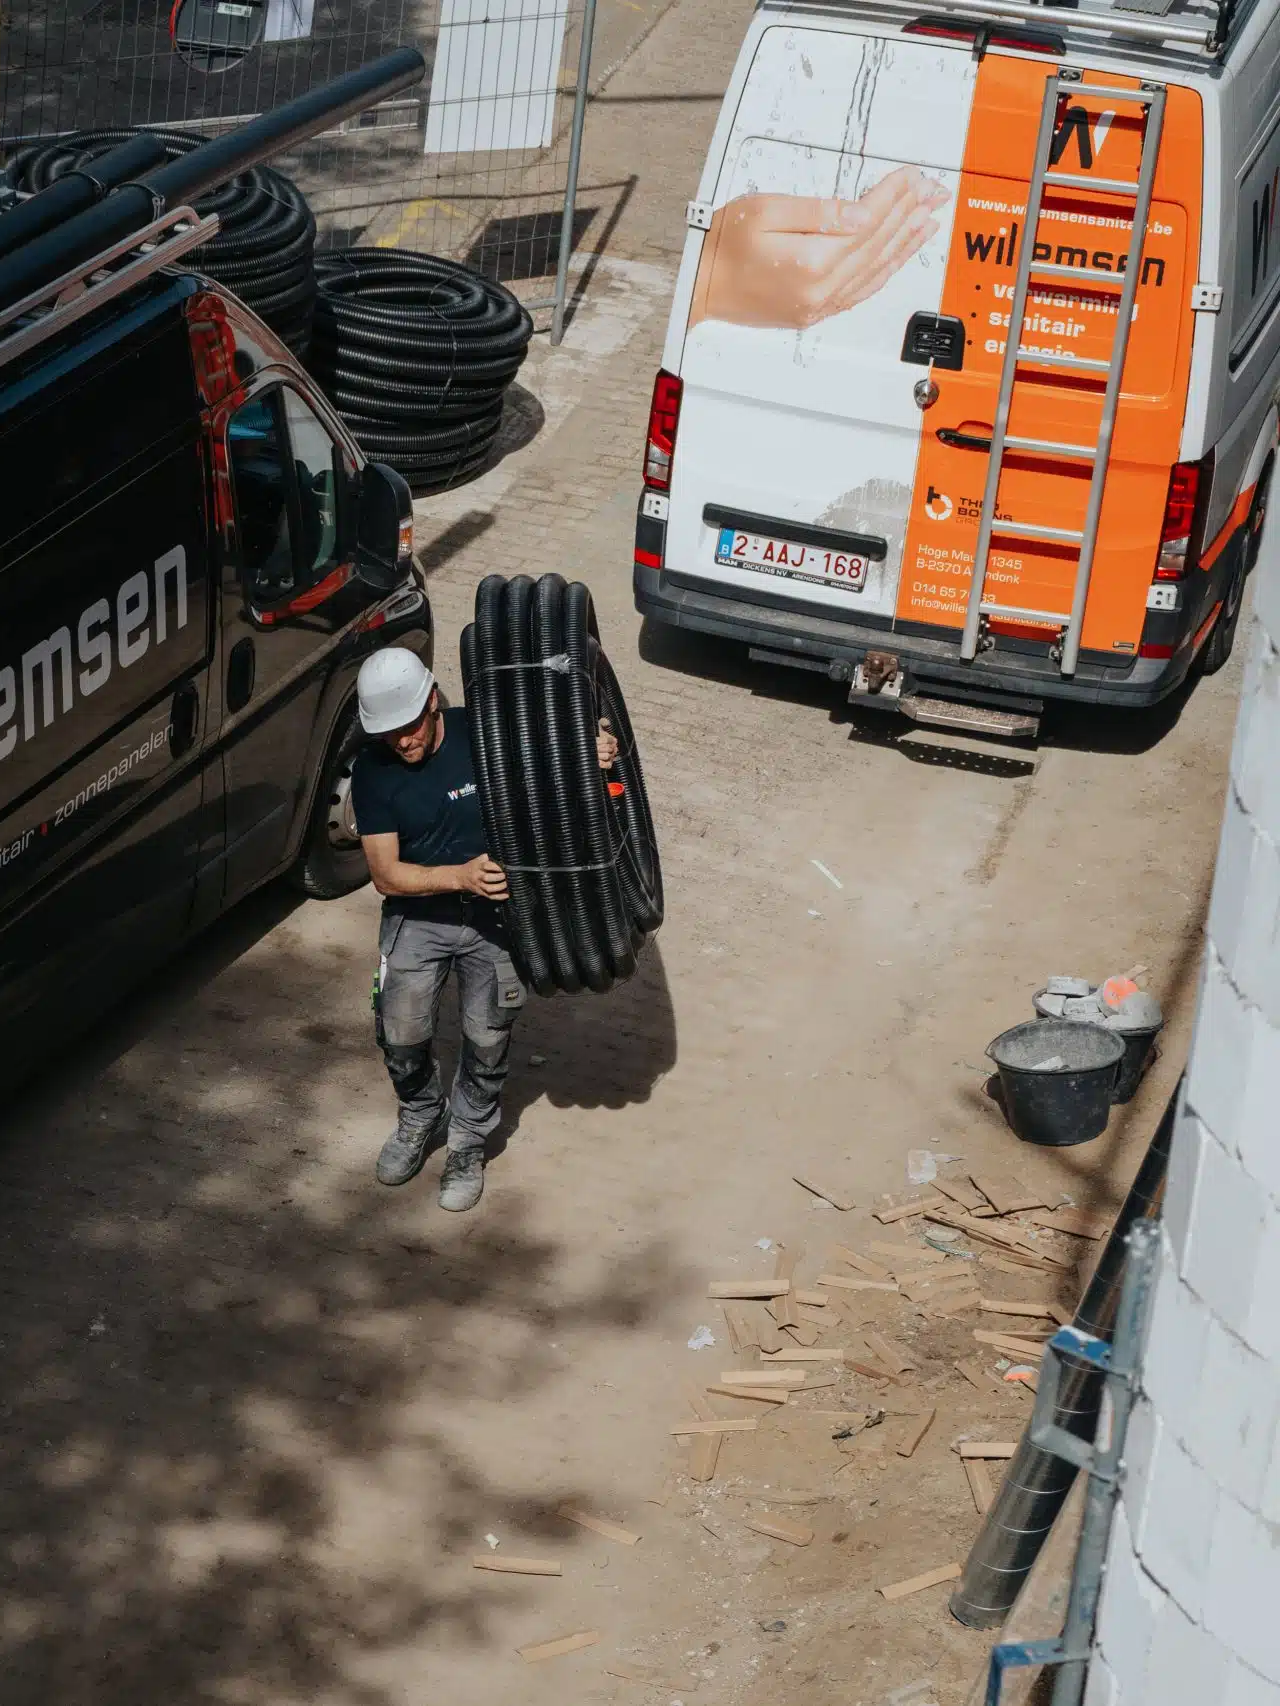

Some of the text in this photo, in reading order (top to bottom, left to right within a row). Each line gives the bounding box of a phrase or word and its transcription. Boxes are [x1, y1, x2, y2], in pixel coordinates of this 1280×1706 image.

[967, 197, 1174, 237] www.wiemsensanita.be
[964, 222, 1166, 287] wilemsn
[993, 283, 1139, 321] vewarmin
[957, 507, 1013, 523] BONS
[718, 557, 738, 568] MAN
[742, 561, 776, 576] DICKENS
[776, 569, 789, 577] NV
[722, 535, 862, 579] B 2-AAJ-168
[915, 558, 1021, 585] B-2370 Andonk
[918, 543, 1024, 571] Hoge Mau 1345
[912, 580, 937, 595] 014
[939, 586, 957, 599] 65
[53, 721, 175, 827] zonnepanelen
